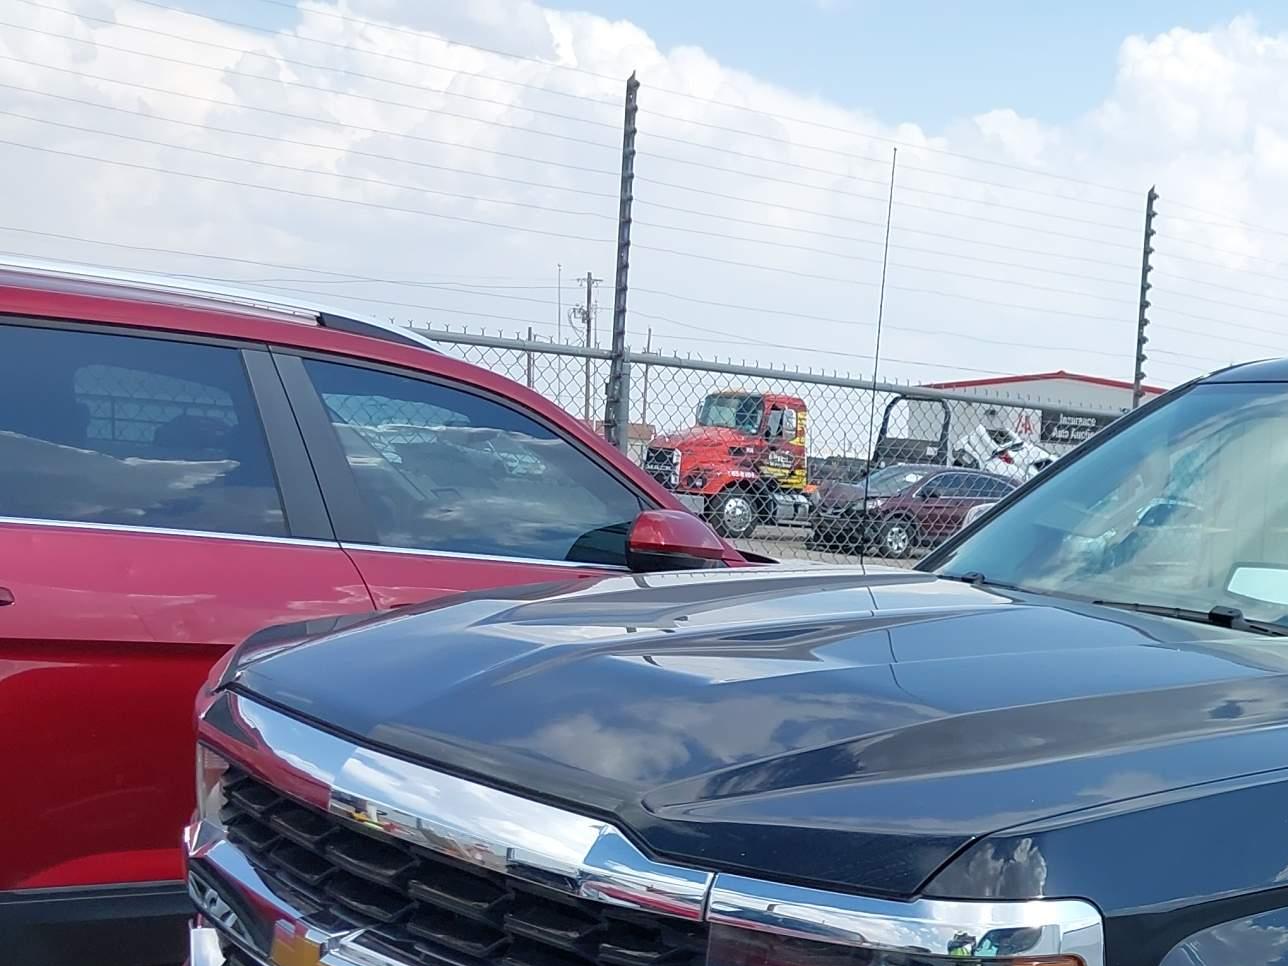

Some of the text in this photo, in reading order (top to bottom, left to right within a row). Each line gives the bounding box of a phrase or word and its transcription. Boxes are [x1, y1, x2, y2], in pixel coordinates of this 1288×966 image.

[1059, 413, 1096, 426] Insurance
[1052, 427, 1096, 439] Auto Auctio
